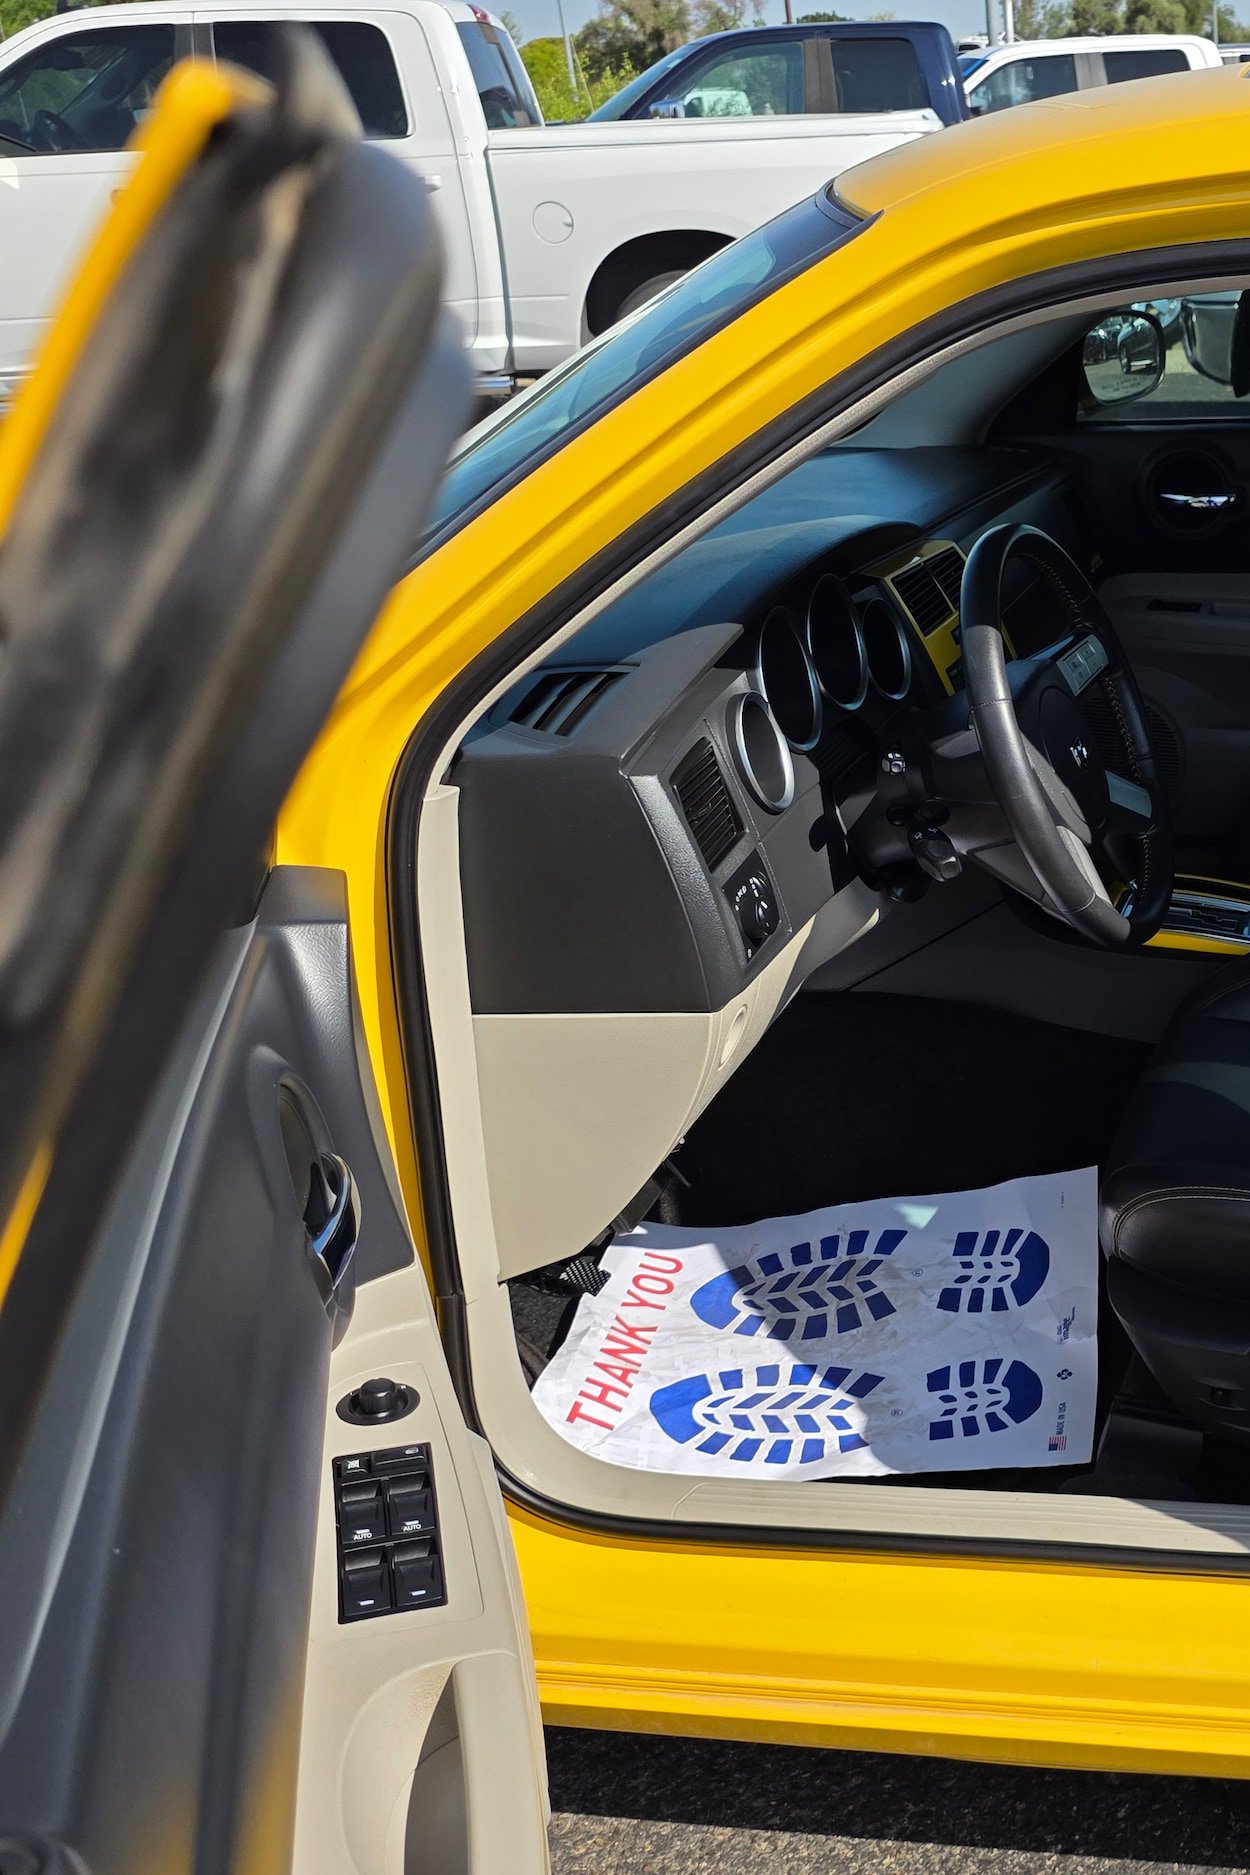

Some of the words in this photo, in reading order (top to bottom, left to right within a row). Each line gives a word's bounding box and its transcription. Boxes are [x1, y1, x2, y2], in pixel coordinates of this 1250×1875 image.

[566, 1314, 659, 1431] THANK
[620, 1251, 684, 1311] YOU
[1058, 1401, 1067, 1413] USA
[1056, 1421, 1065, 1435] MADE
[403, 1523, 422, 1532] AUTO
[353, 1532, 373, 1541] AUTO
